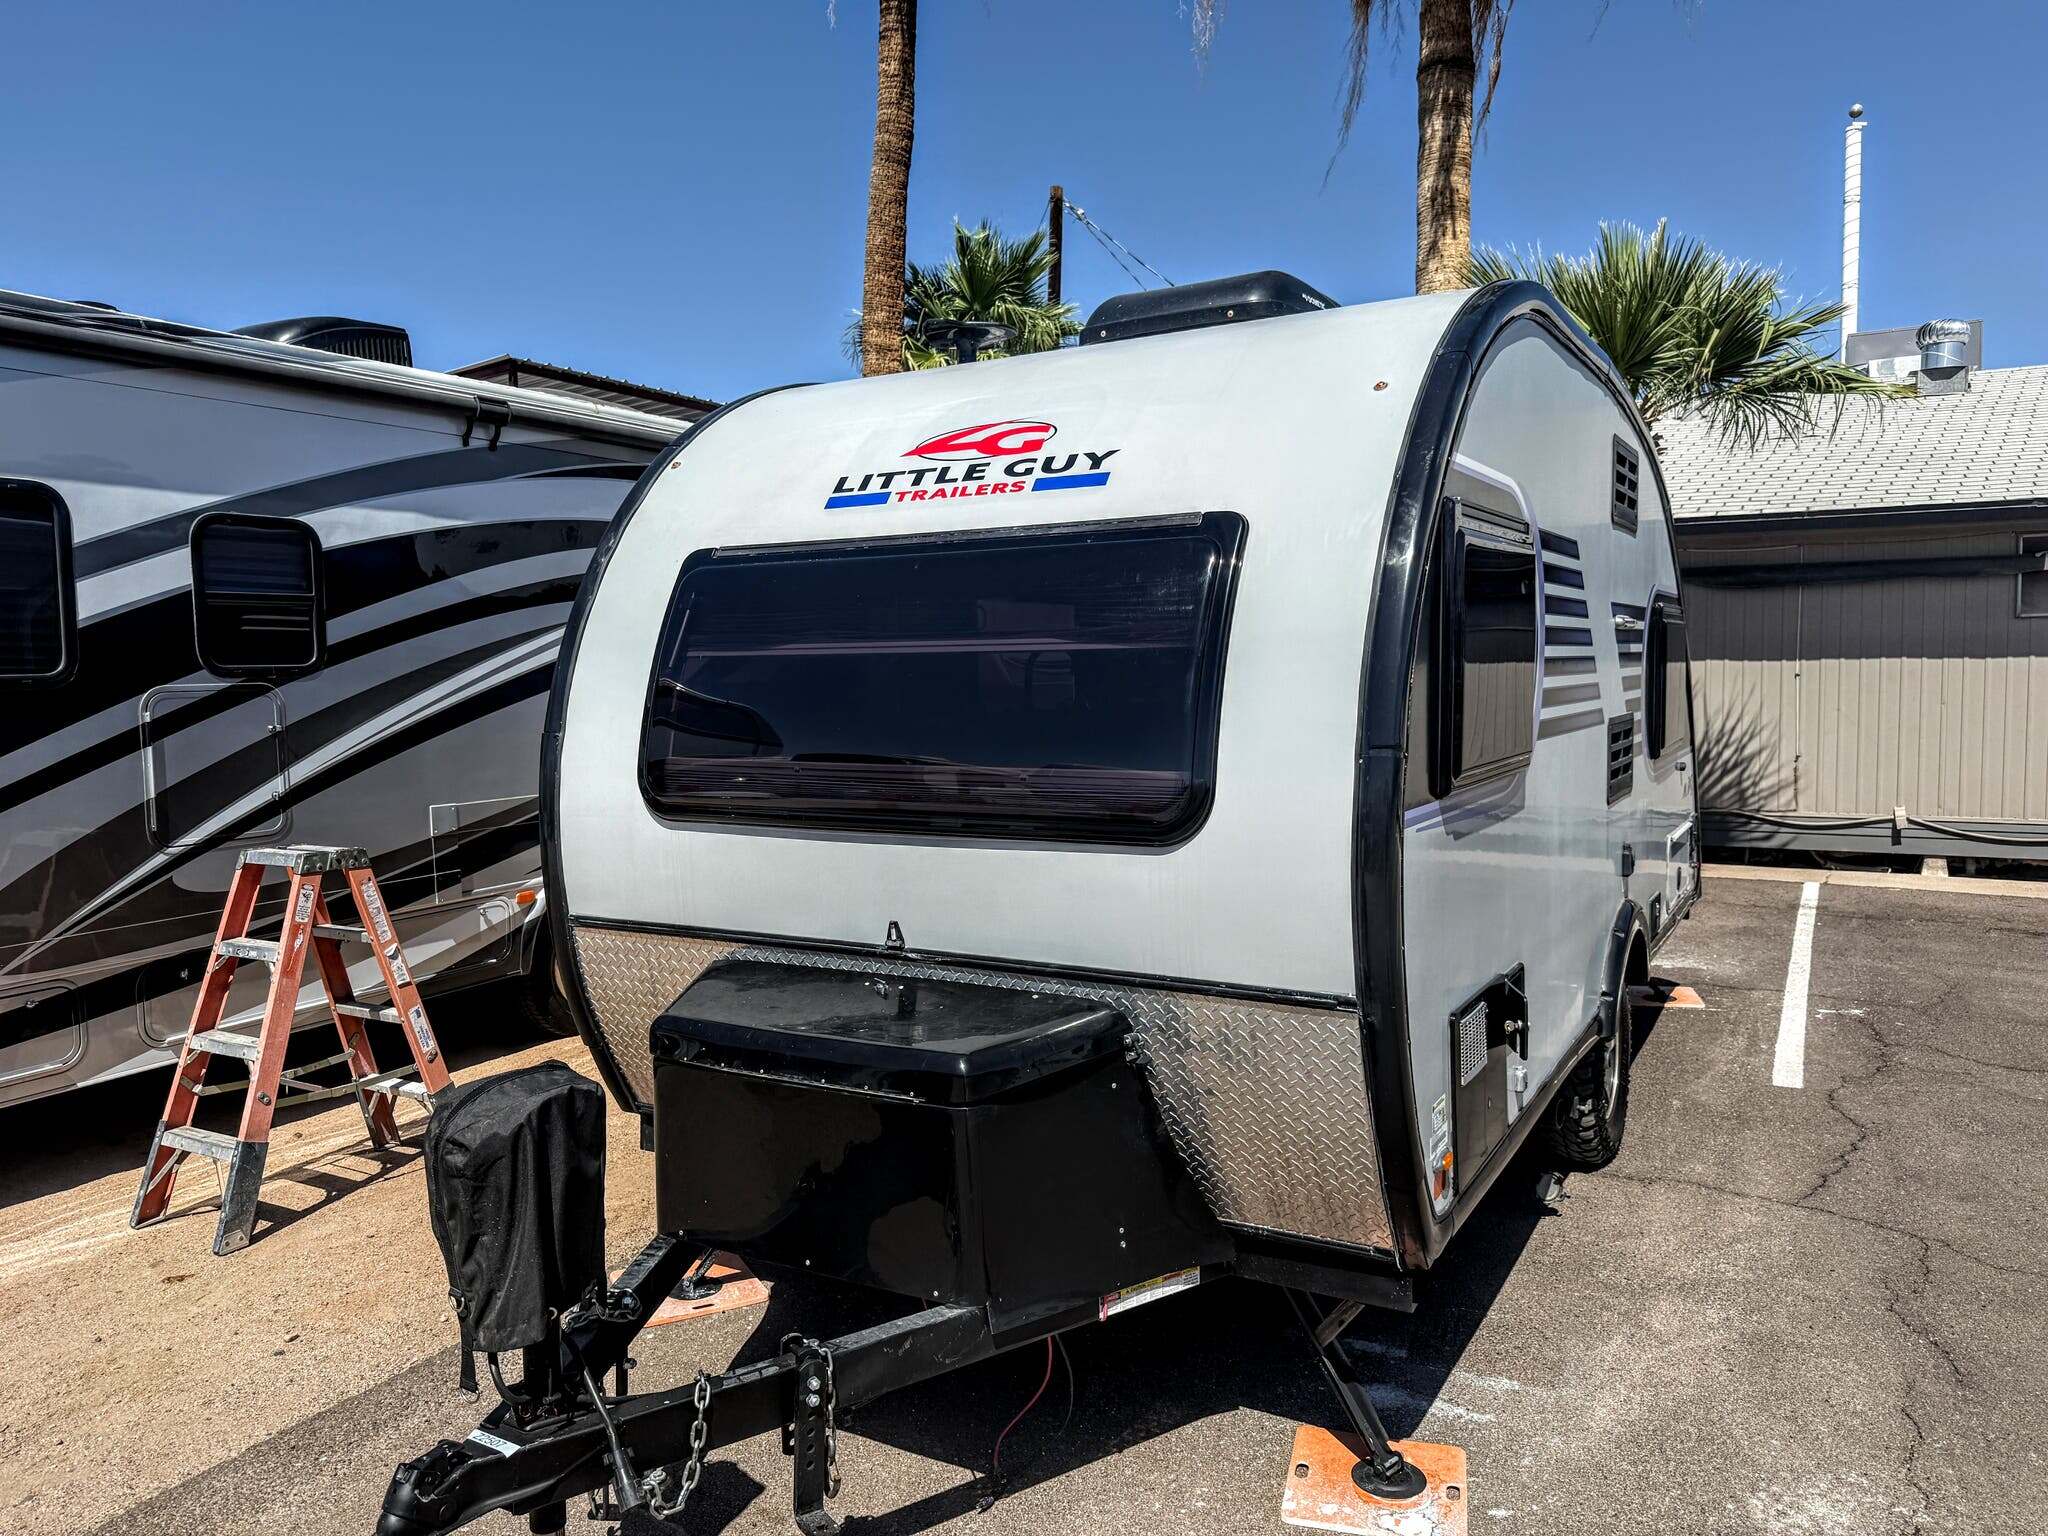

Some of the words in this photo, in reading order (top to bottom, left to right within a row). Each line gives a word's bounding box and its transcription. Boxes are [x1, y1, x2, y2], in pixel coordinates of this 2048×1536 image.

[832, 462, 991, 493] LITTLE
[1004, 449, 1121, 477] GUY
[895, 480, 1027, 502] TRAILERS
